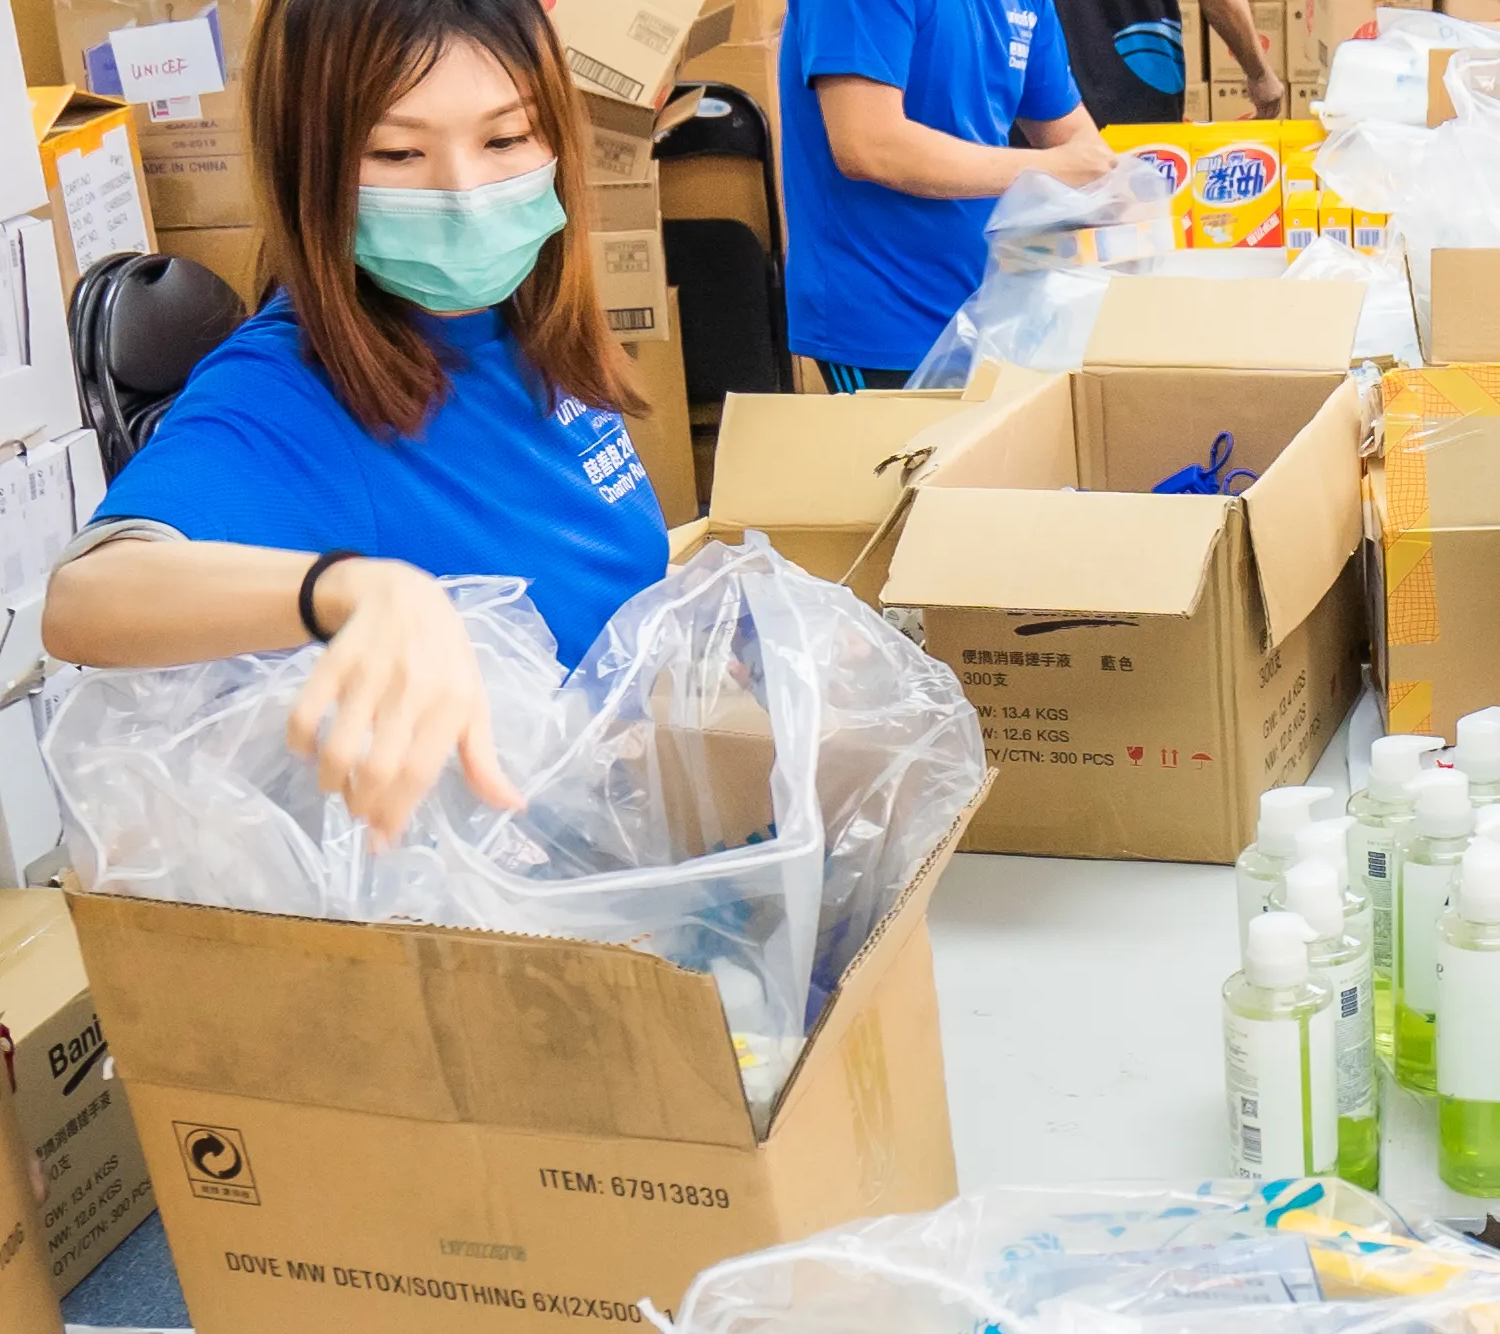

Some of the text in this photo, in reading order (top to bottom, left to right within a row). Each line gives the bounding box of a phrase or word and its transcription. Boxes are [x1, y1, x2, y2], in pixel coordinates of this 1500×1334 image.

[131, 58, 188, 80] UNICEF
[142, 161, 171, 175] ADE
[189, 160, 228, 172] CHINA
[599, 460, 647, 504] Charity Ru
[1101, 654, 1134, 673] 藍色
[963, 671, 1008, 687] 300支
[976, 705, 1069, 721] W: 13.4 KGS
[982, 727, 1070, 743] W: 12.6 KGS
[985, 747, 1114, 766] TY/CTN: 300 PCS
[44, 1203, 69, 1230] GW:
[94, 1154, 119, 1181] KGS
[539, 1167, 730, 1209] ITEM: 67913839
[48, 1178, 123, 1253] NW: 12.6 KGS
[53, 1220, 110, 1278] QTY/CTN:
[110, 1197, 131, 1224] 300
[225, 1251, 282, 1278] DOVE
[287, 1259, 326, 1284] MW
[333, 1266, 527, 1311] DETOX/SOOTHING
